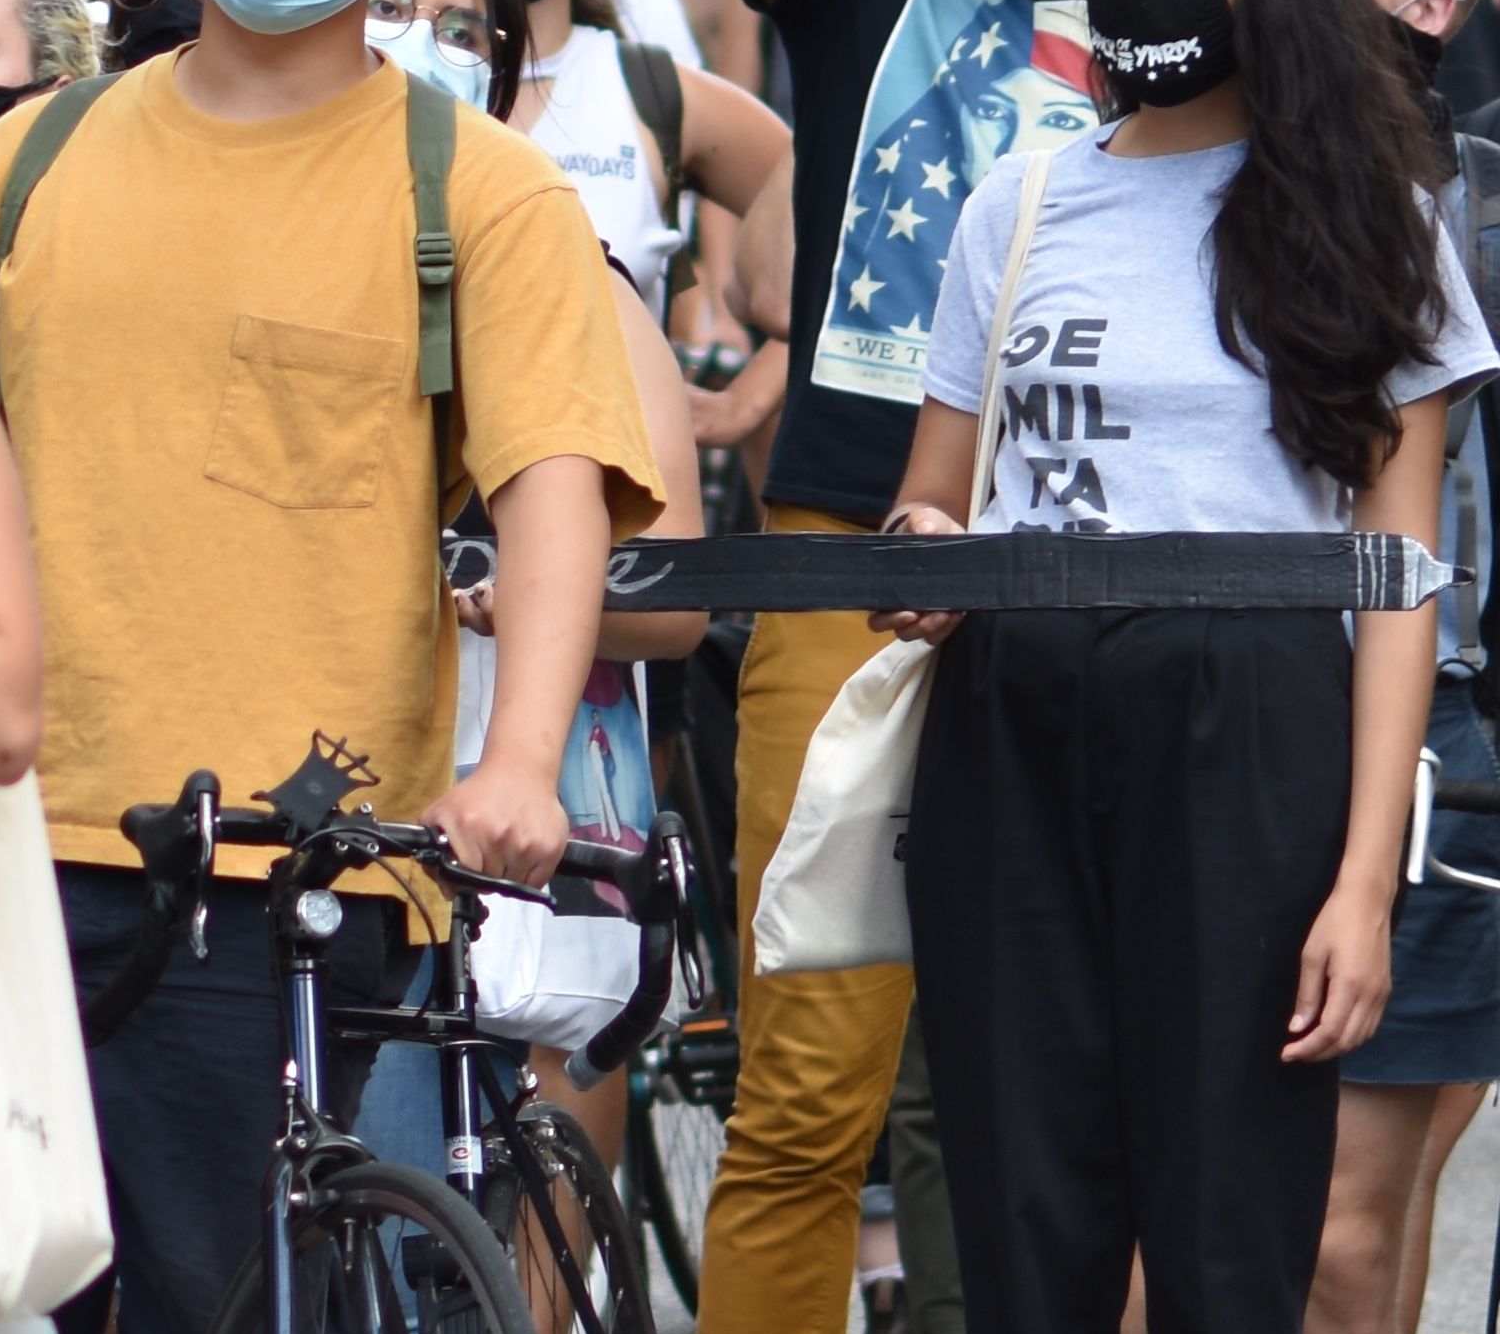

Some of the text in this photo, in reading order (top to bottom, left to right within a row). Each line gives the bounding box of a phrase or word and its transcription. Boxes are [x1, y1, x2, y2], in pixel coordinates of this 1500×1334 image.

[1133, 35, 1203, 68] YARDS
[855, 337, 897, 360] WE
[1000, 318, 1108, 368] DE
[1003, 383, 1131, 442] MIL
